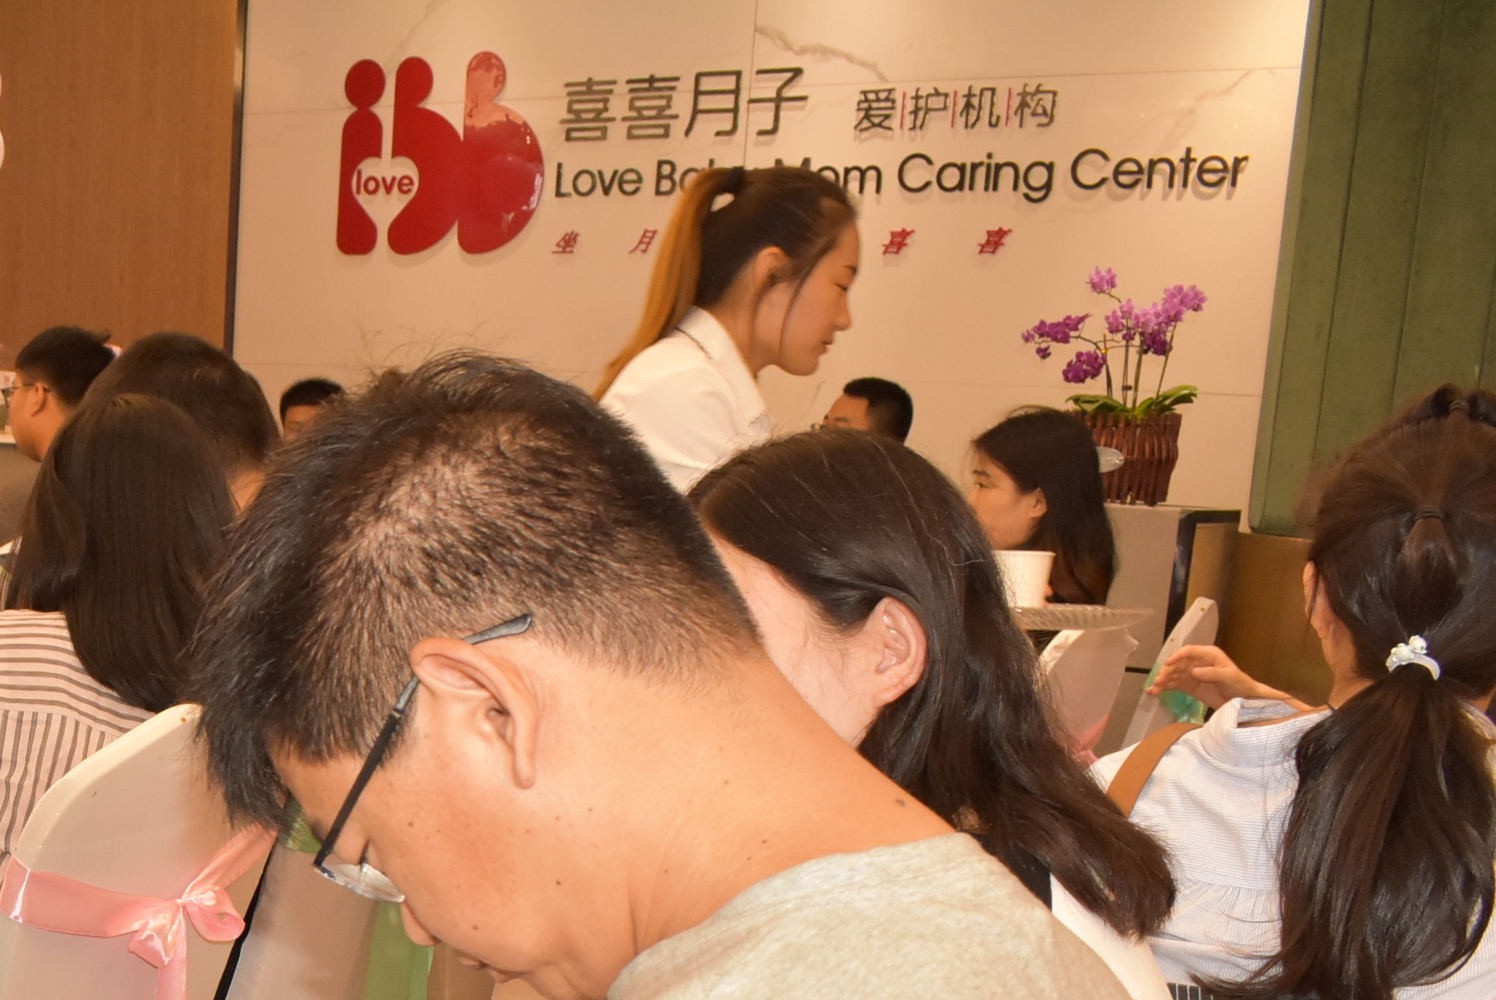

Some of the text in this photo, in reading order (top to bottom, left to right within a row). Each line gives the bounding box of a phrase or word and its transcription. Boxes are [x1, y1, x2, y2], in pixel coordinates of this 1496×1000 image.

[558, 66, 809, 142] 喜喜月子
[355, 169, 415, 195] love
[554, 162, 643, 198] Love
[897, 152, 1055, 203] Caring
[1070, 147, 1249, 191] Center
